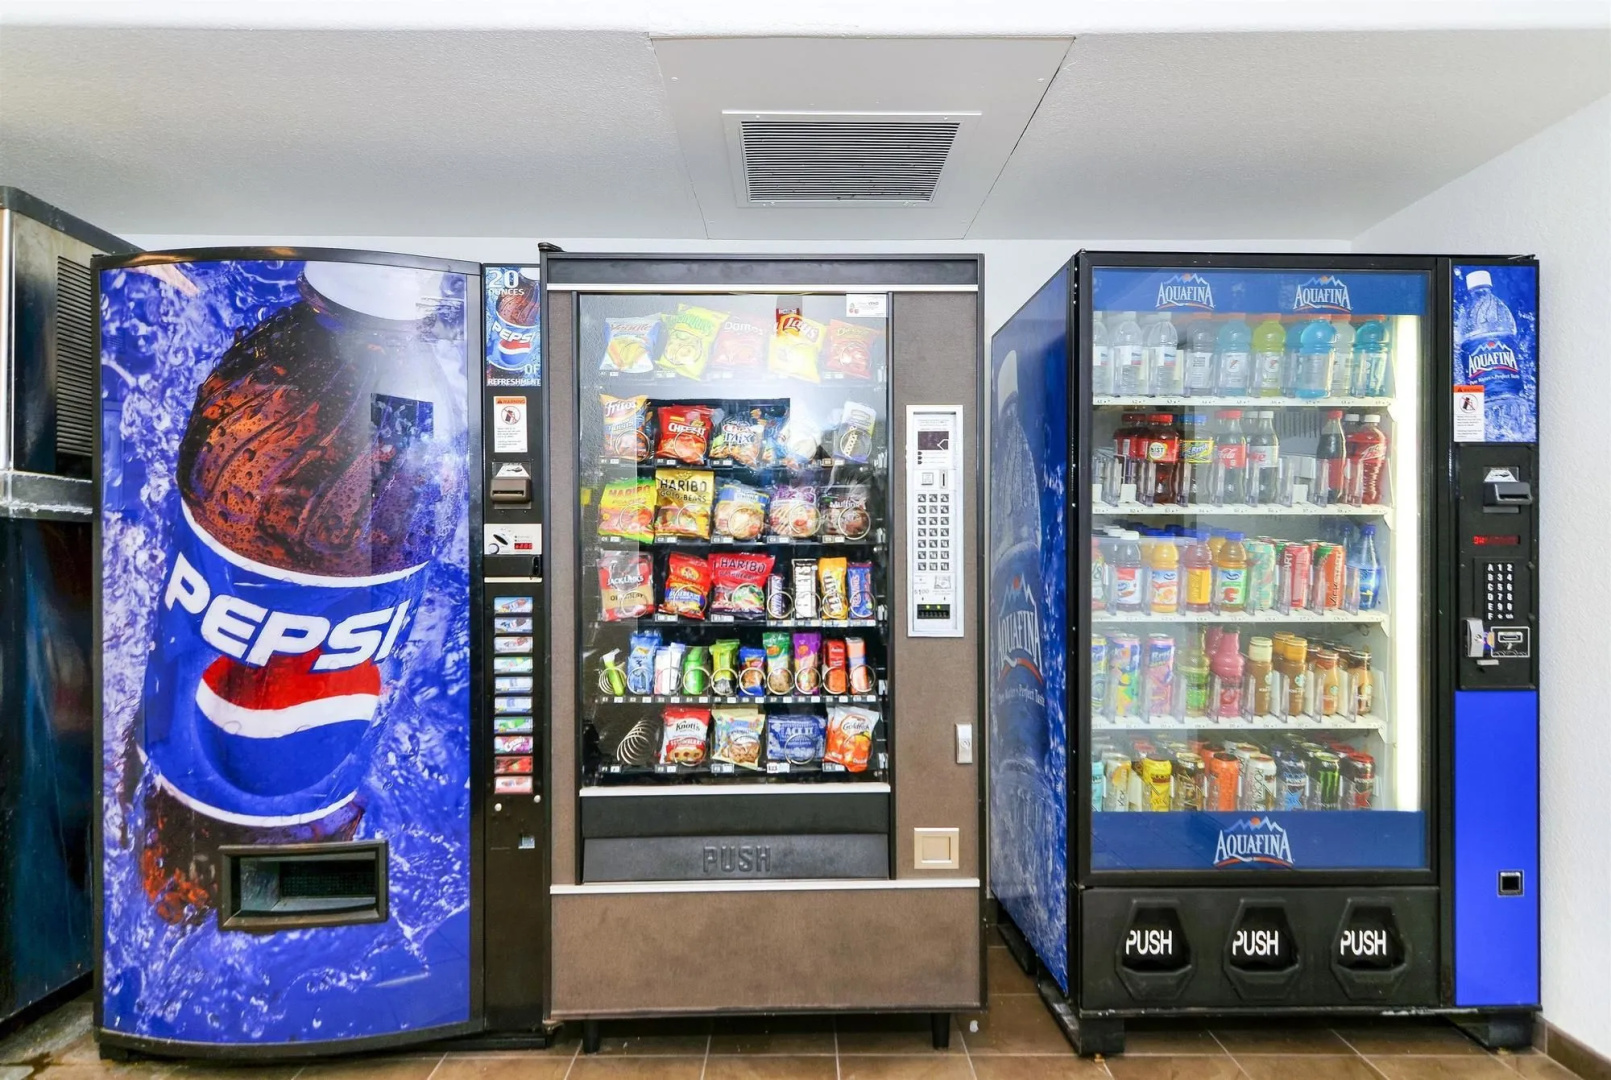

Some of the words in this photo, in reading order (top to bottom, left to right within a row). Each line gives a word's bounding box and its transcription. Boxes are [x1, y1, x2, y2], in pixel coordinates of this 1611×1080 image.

[489, 270, 519, 289] 20
[1155, 282, 1215, 309] AQUAFINA
[1292, 284, 1352, 310] AQUAFINA
[492, 321, 535, 343] PEPSI
[524, 364, 540, 375] OF
[1468, 350, 1518, 378] AQUAFINA
[487, 378, 541, 386] REFRESHMENT
[660, 479, 707, 493] HARIBO
[720, 557, 767, 574] HARIBO
[1487, 583, 1494, 591] C
[1497, 583, 1503, 591] 5
[1497, 593, 1503, 601] 7
[165, 552, 410, 673] PEPSI
[998, 602, 1044, 681] AQUAFINA
[675, 720, 701, 731] Knott's
[703, 844, 771, 873] PUSH
[1213, 829, 1294, 865] AQUAFINA
[1125, 929, 1173, 955] PUSH
[1232, 929, 1279, 956] PUSH
[1339, 929, 1387, 956] PUSH
